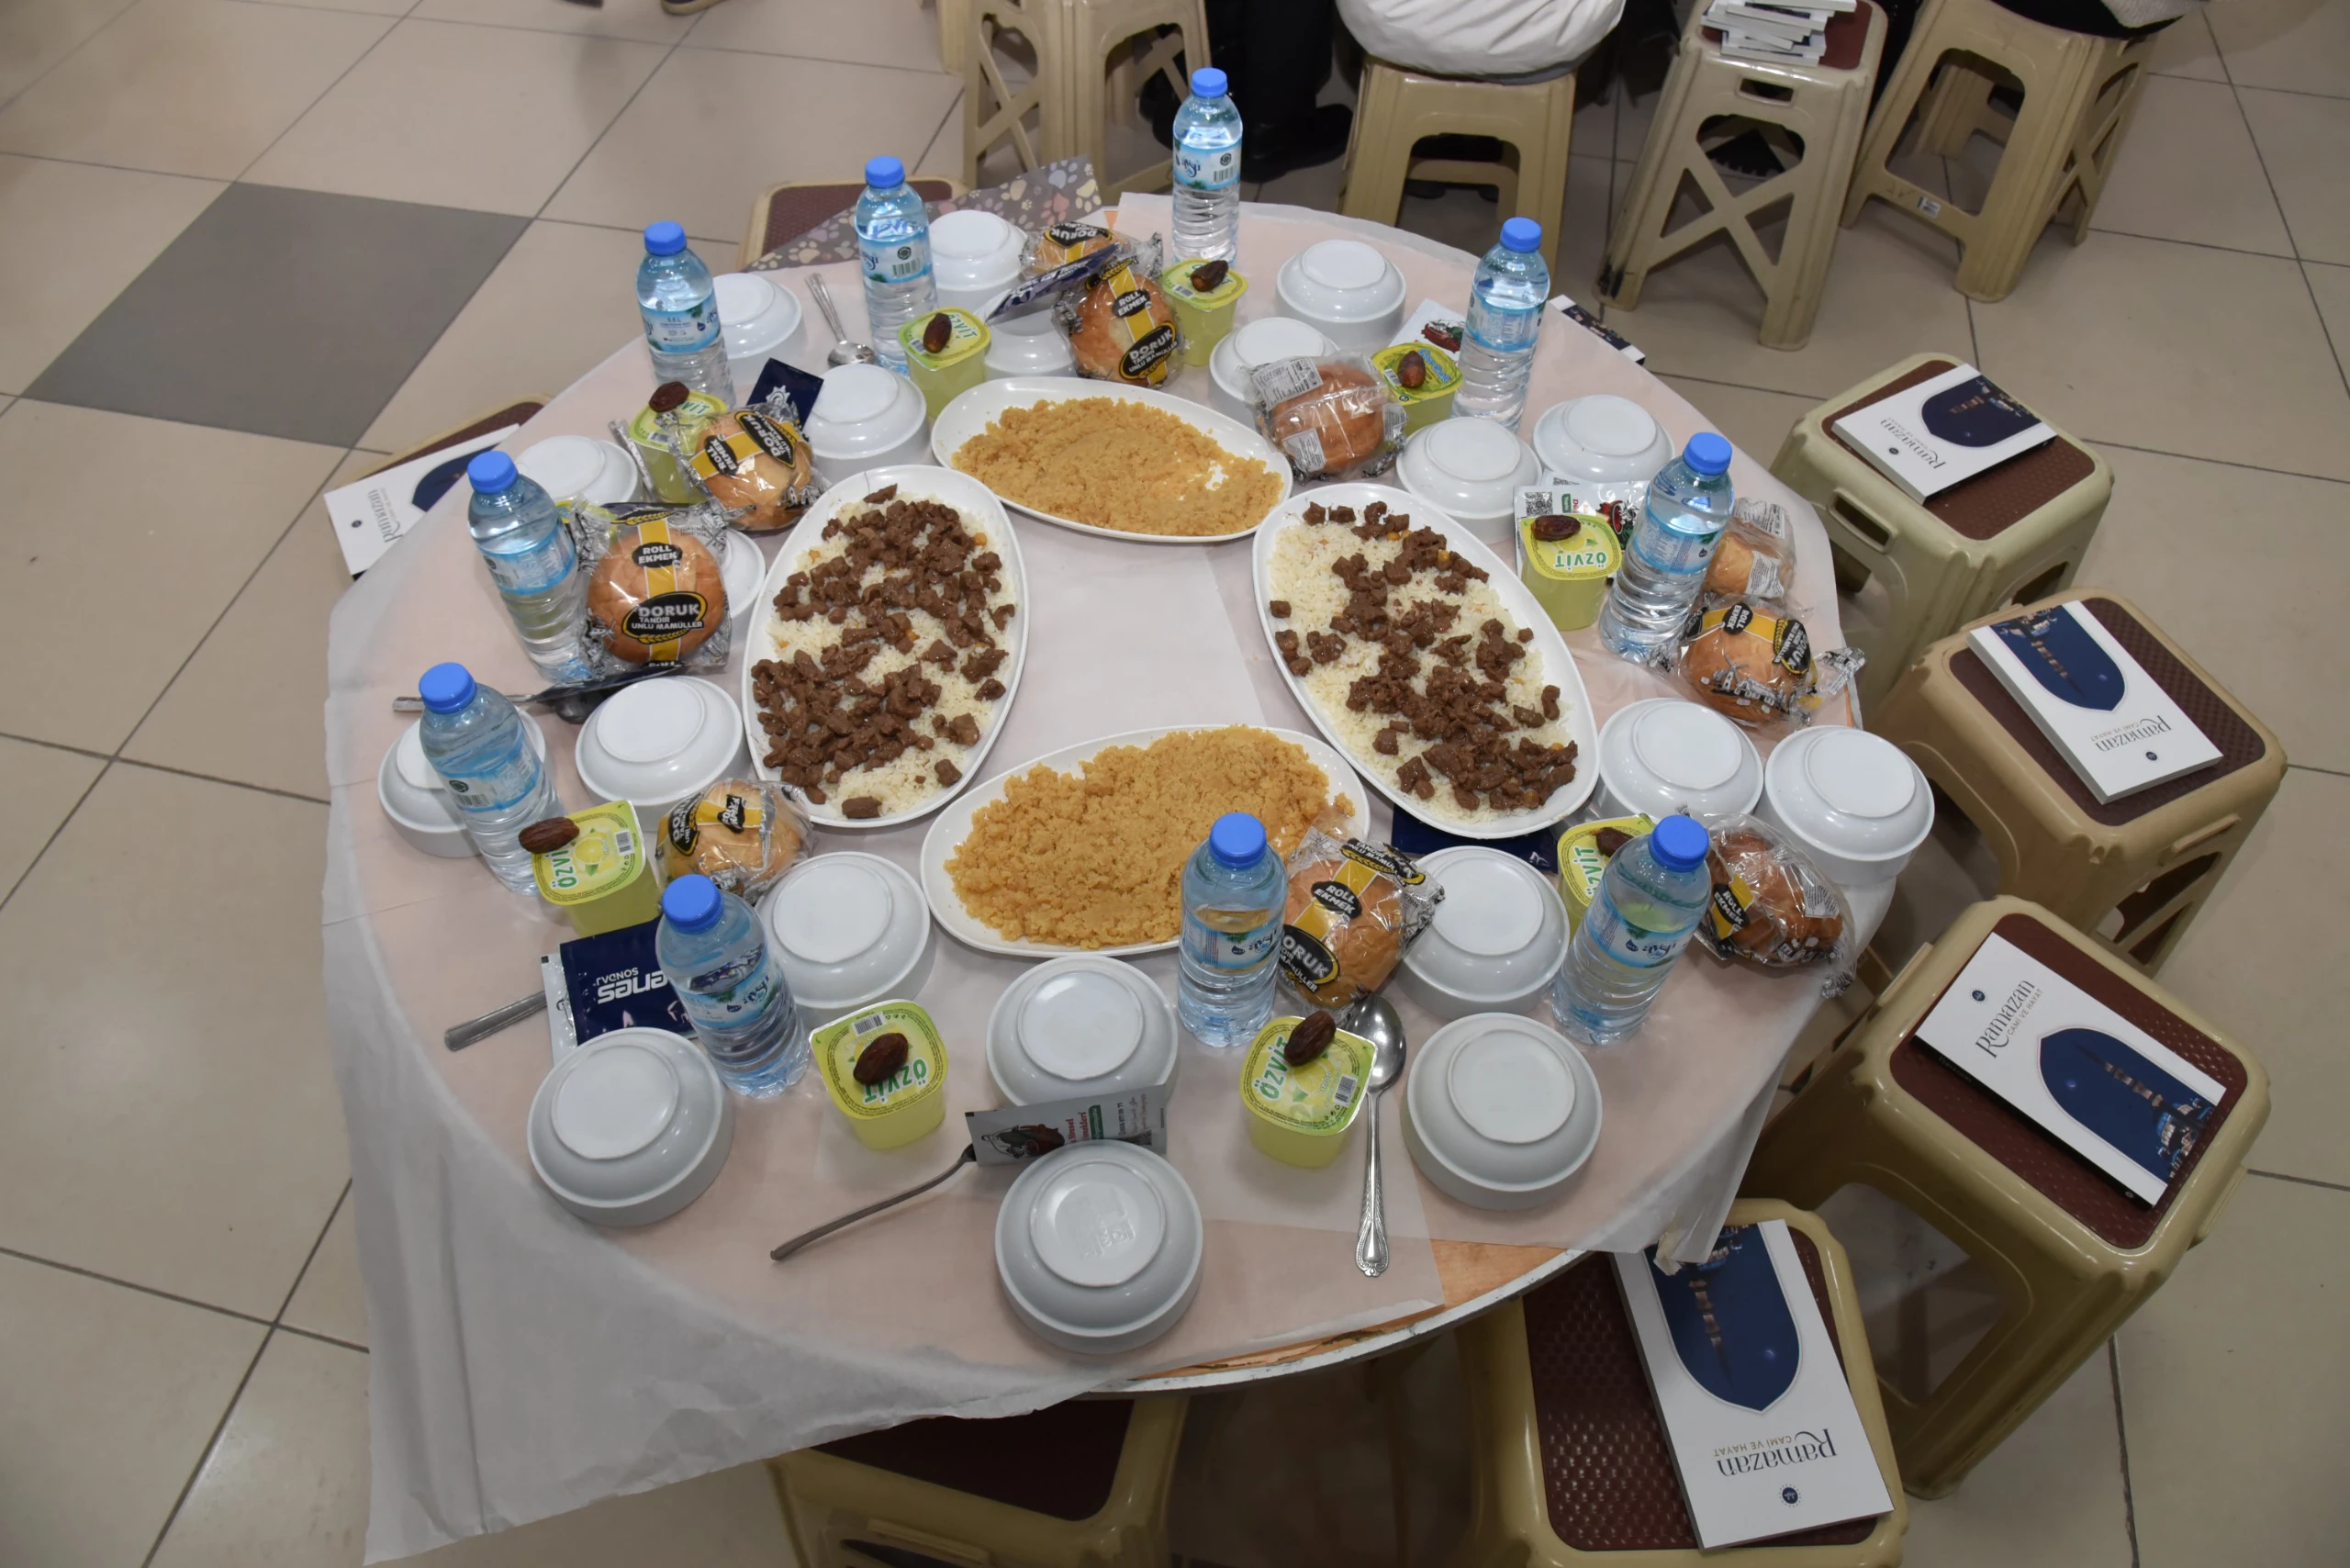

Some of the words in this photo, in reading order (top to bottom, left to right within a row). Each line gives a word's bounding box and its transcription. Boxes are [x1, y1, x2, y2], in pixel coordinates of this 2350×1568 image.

[1117, 296, 1147, 316] EKMEK
[1118, 291, 1141, 307] ROLL
[1129, 329, 1173, 360] DORUK
[1132, 349, 1156, 364] TANDIR
[1128, 361, 1147, 373] UNLU
[681, 401, 711, 414] VİT
[743, 414, 782, 458] DORUK
[1880, 420, 1946, 469] Ramazan
[707, 445, 727, 470] ROLL
[710, 439, 737, 470] EKMEK
[638, 552, 677, 564] EKMEK
[643, 545, 672, 554] ROLL
[1555, 551, 1607, 571] ÖZVİT
[637, 603, 700, 618] DORUK
[1726, 605, 1742, 630] EKMEK
[1736, 609, 1751, 629] ROLL
[655, 621, 703, 630] MAMÜLLER
[2096, 715, 2172, 752] Ramazan
[1356, 841, 1385, 858] TANDIR
[545, 850, 577, 888] ÖZVİ
[1314, 888, 1356, 914] EKMEK
[1326, 885, 1356, 904] ROLL
[1722, 890, 1742, 916] ROLL
[1714, 891, 1744, 925] EKMEK
[1282, 935, 1330, 979] ORUK
[596, 967, 639, 986] SONDAJ
[1975, 980, 2035, 1058] Ramazan
[1714, 1442, 1748, 1458] HAYAT
[1751, 1439, 1764, 1450] VE
[1766, 1435, 1793, 1449] CAMİ
[1717, 1428, 1838, 1477] Ramazan
